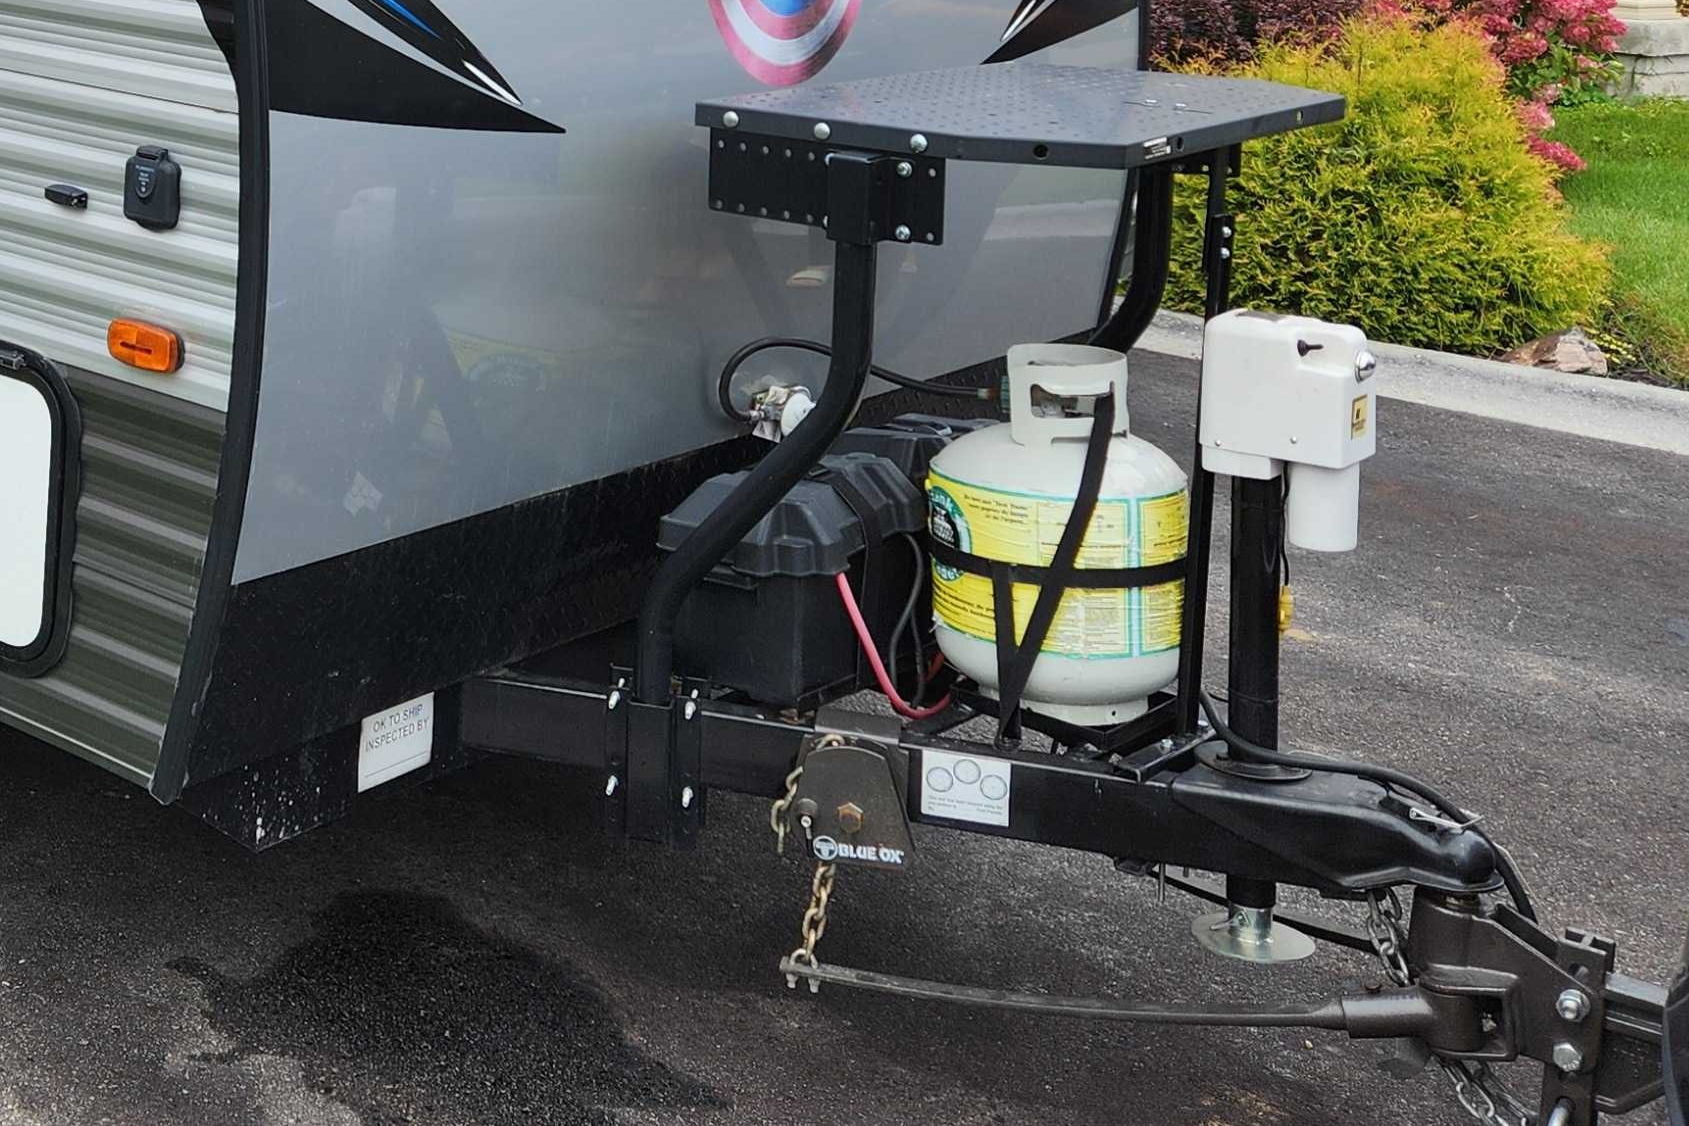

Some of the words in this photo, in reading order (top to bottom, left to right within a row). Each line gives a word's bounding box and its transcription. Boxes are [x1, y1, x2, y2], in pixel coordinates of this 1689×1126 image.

[373, 719, 386, 733] OK
[389, 712, 401, 725] TO
[403, 703, 423, 721] SHIP
[365, 723, 415, 752] INSPECTED
[416, 718, 429, 732] BY
[838, 842, 877, 861] BLUE
[878, 845, 904, 864] OX
